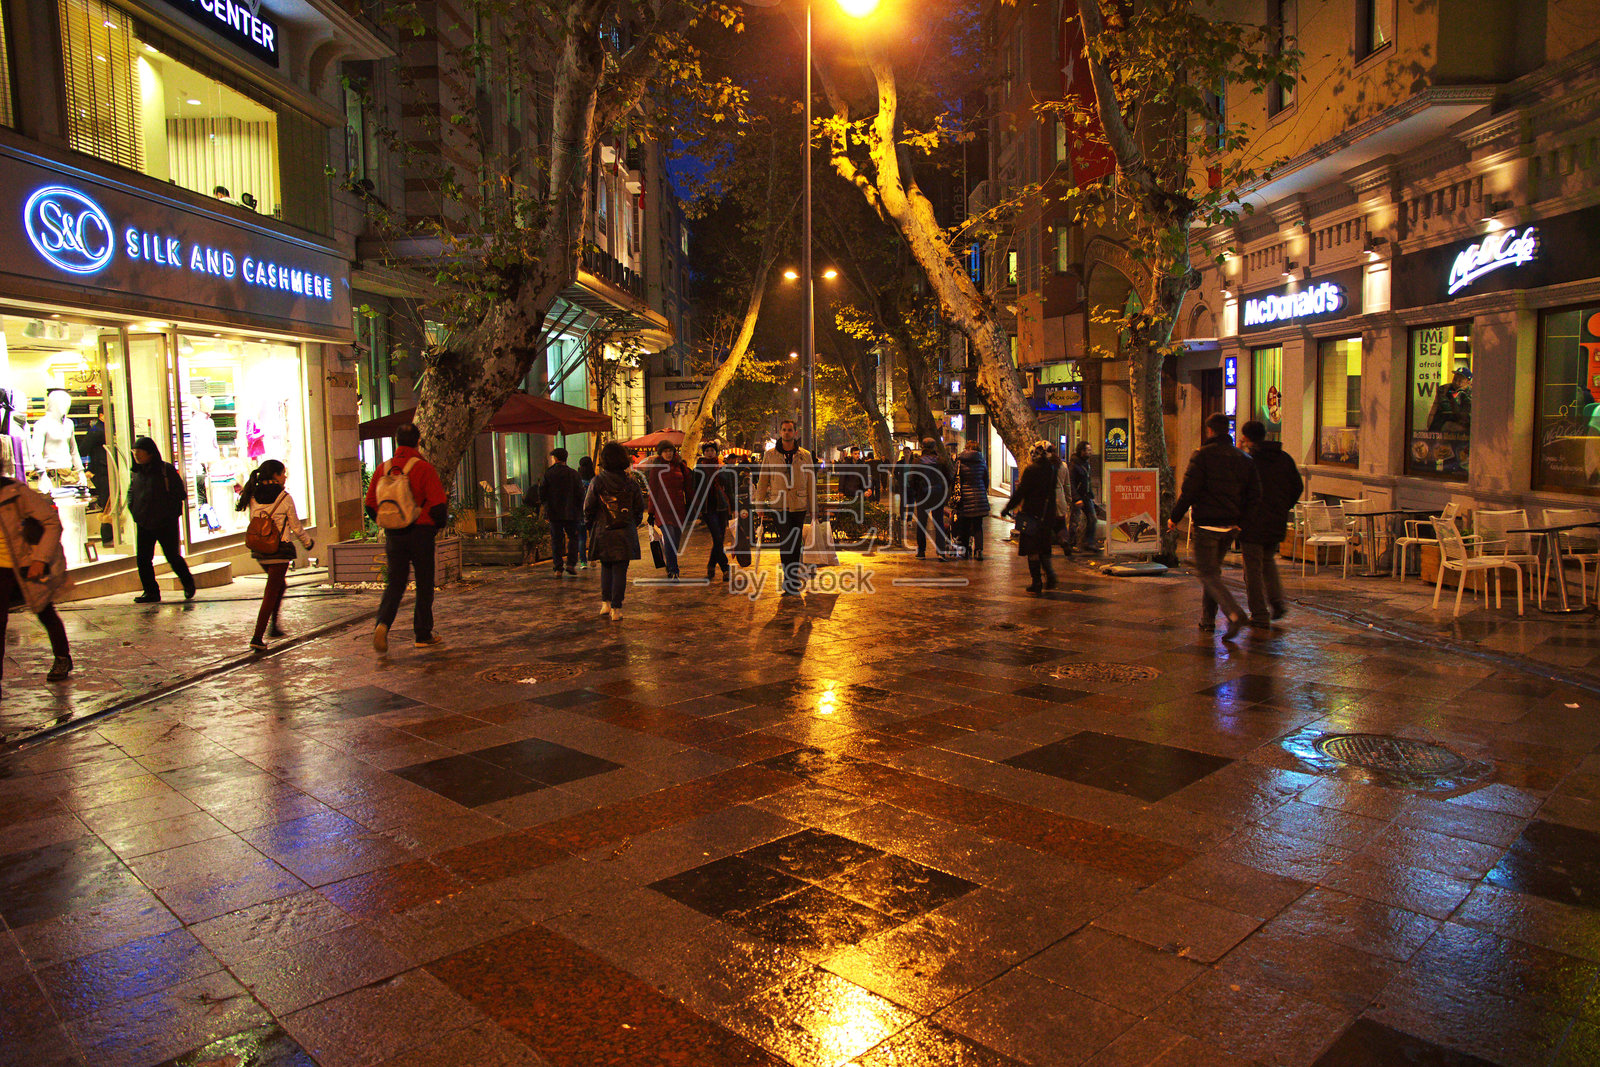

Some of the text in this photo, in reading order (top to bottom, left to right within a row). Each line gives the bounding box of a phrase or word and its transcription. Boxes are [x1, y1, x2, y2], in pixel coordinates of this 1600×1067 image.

[126, 228, 333, 300] SILK AND CASHMERE
[1244, 282, 1340, 327] McDonald's
